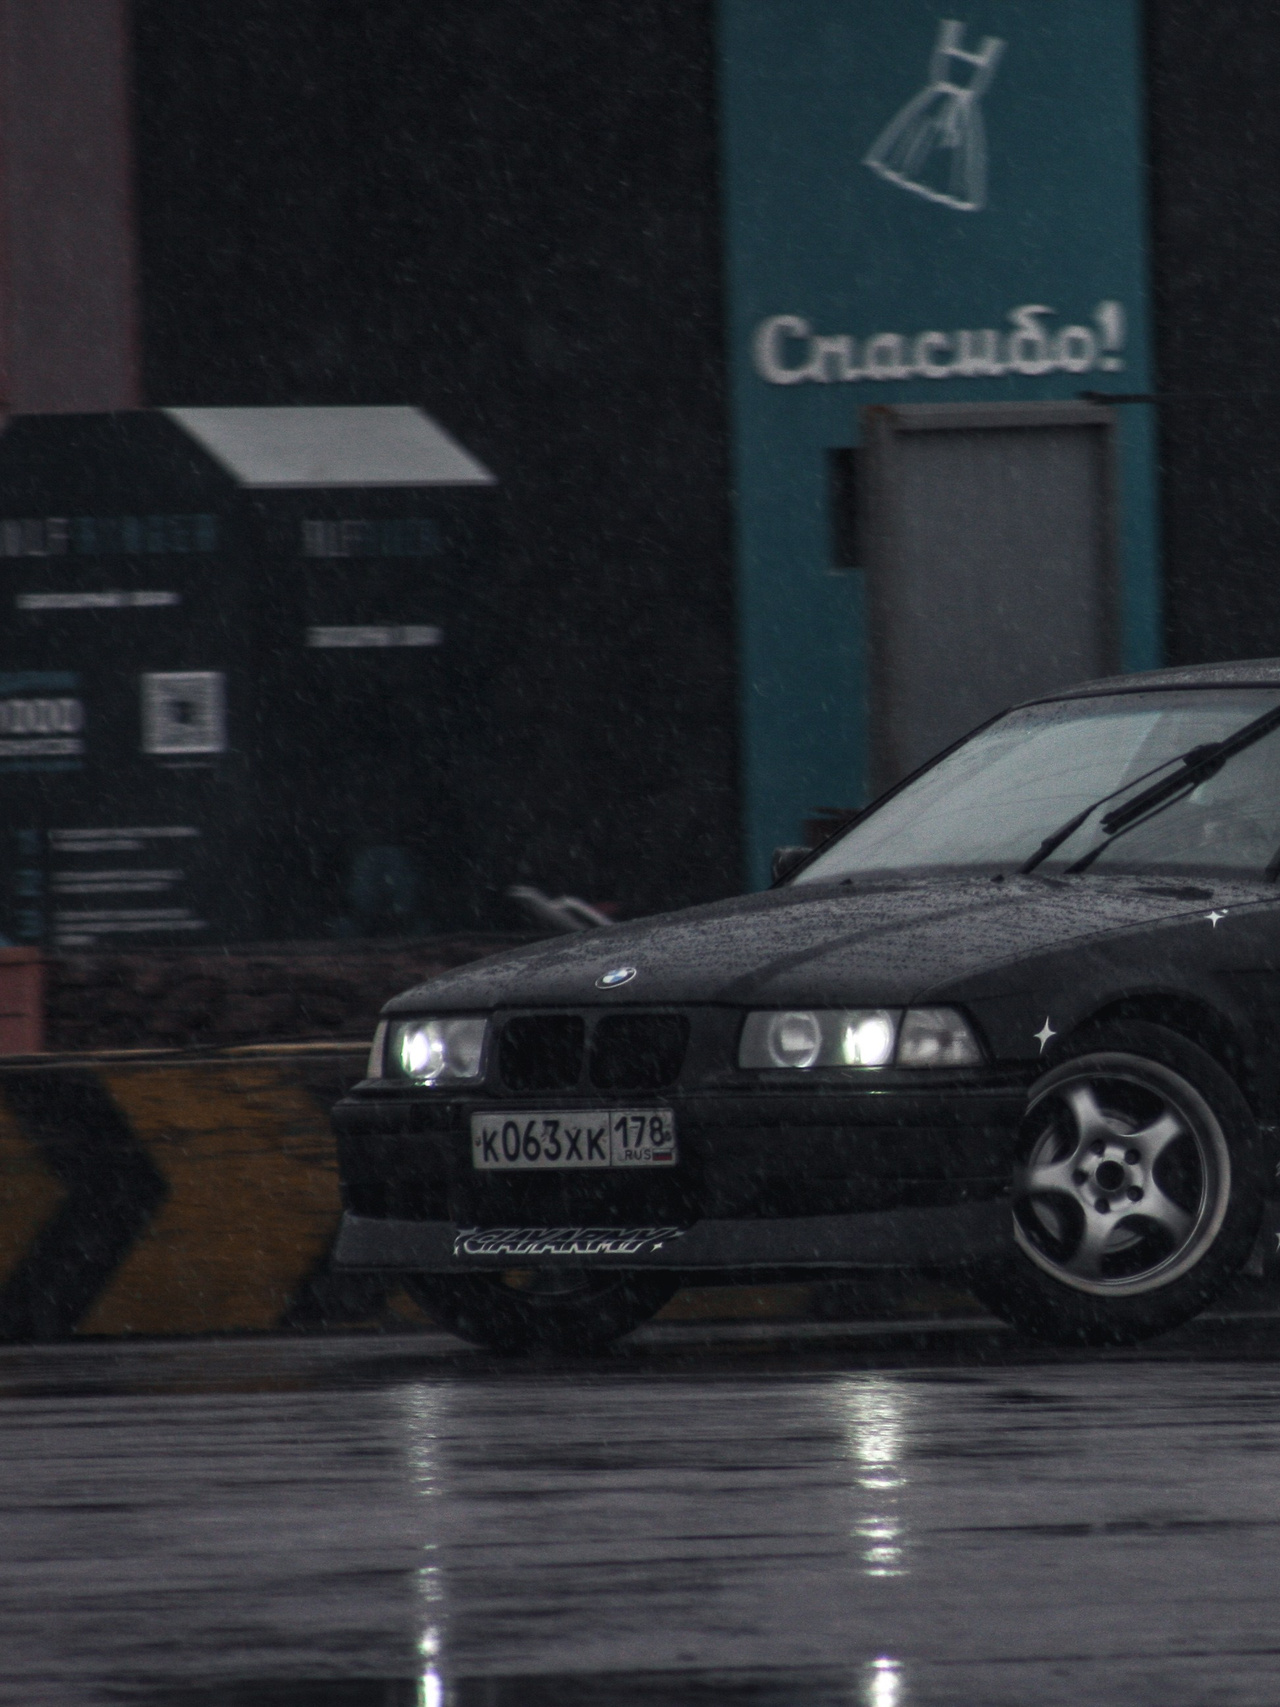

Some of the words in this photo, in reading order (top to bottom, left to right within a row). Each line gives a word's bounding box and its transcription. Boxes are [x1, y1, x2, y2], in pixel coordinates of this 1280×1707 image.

[754, 300, 1127, 385] Спасибо!
[614, 1116, 664, 1148] 178
[624, 1149, 651, 1161] RUS
